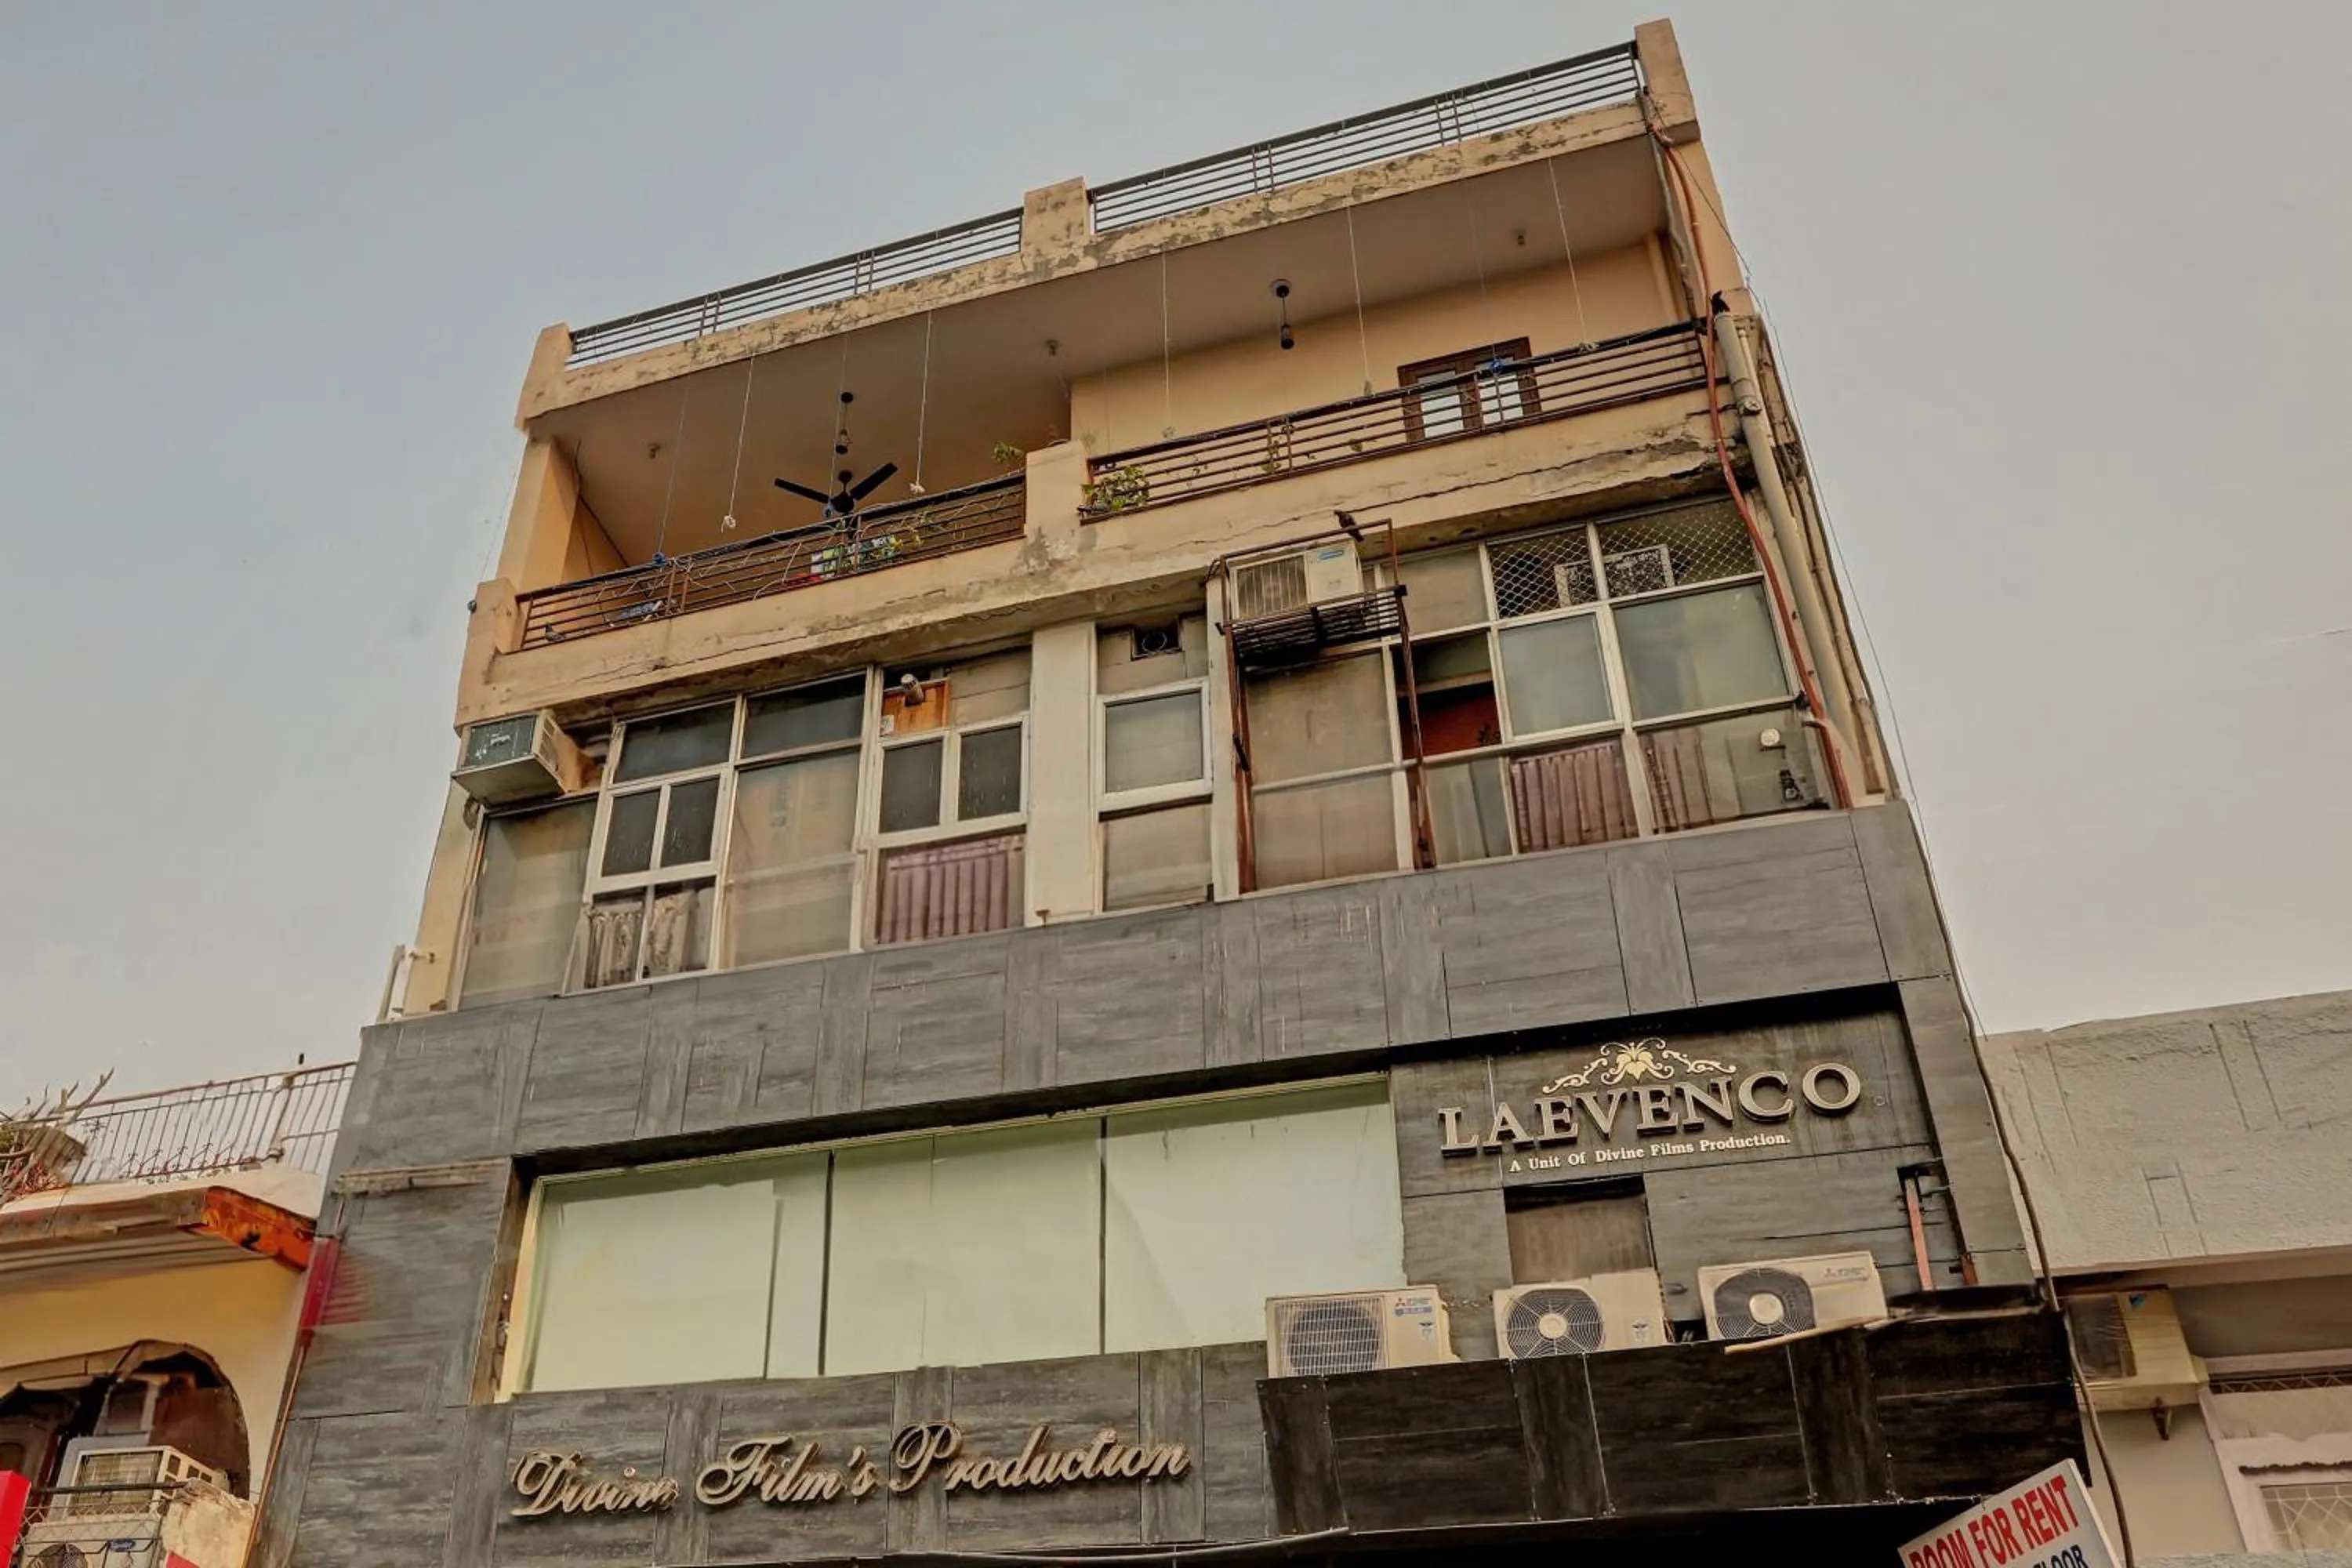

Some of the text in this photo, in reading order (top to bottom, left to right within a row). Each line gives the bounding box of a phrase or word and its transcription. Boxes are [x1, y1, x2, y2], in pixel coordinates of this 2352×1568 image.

[1438, 1062, 1861, 1156] LAEVENCO
[1508, 1133, 1791, 1173] A Unit Of Divine Films Production.
[695, 1433, 878, 1506] Film's
[889, 1421, 1191, 1493] Production
[1967, 1507, 2024, 1568] FOR
[2009, 1474, 2080, 1550] RENT
[2032, 1544, 2090, 1568] OOR
